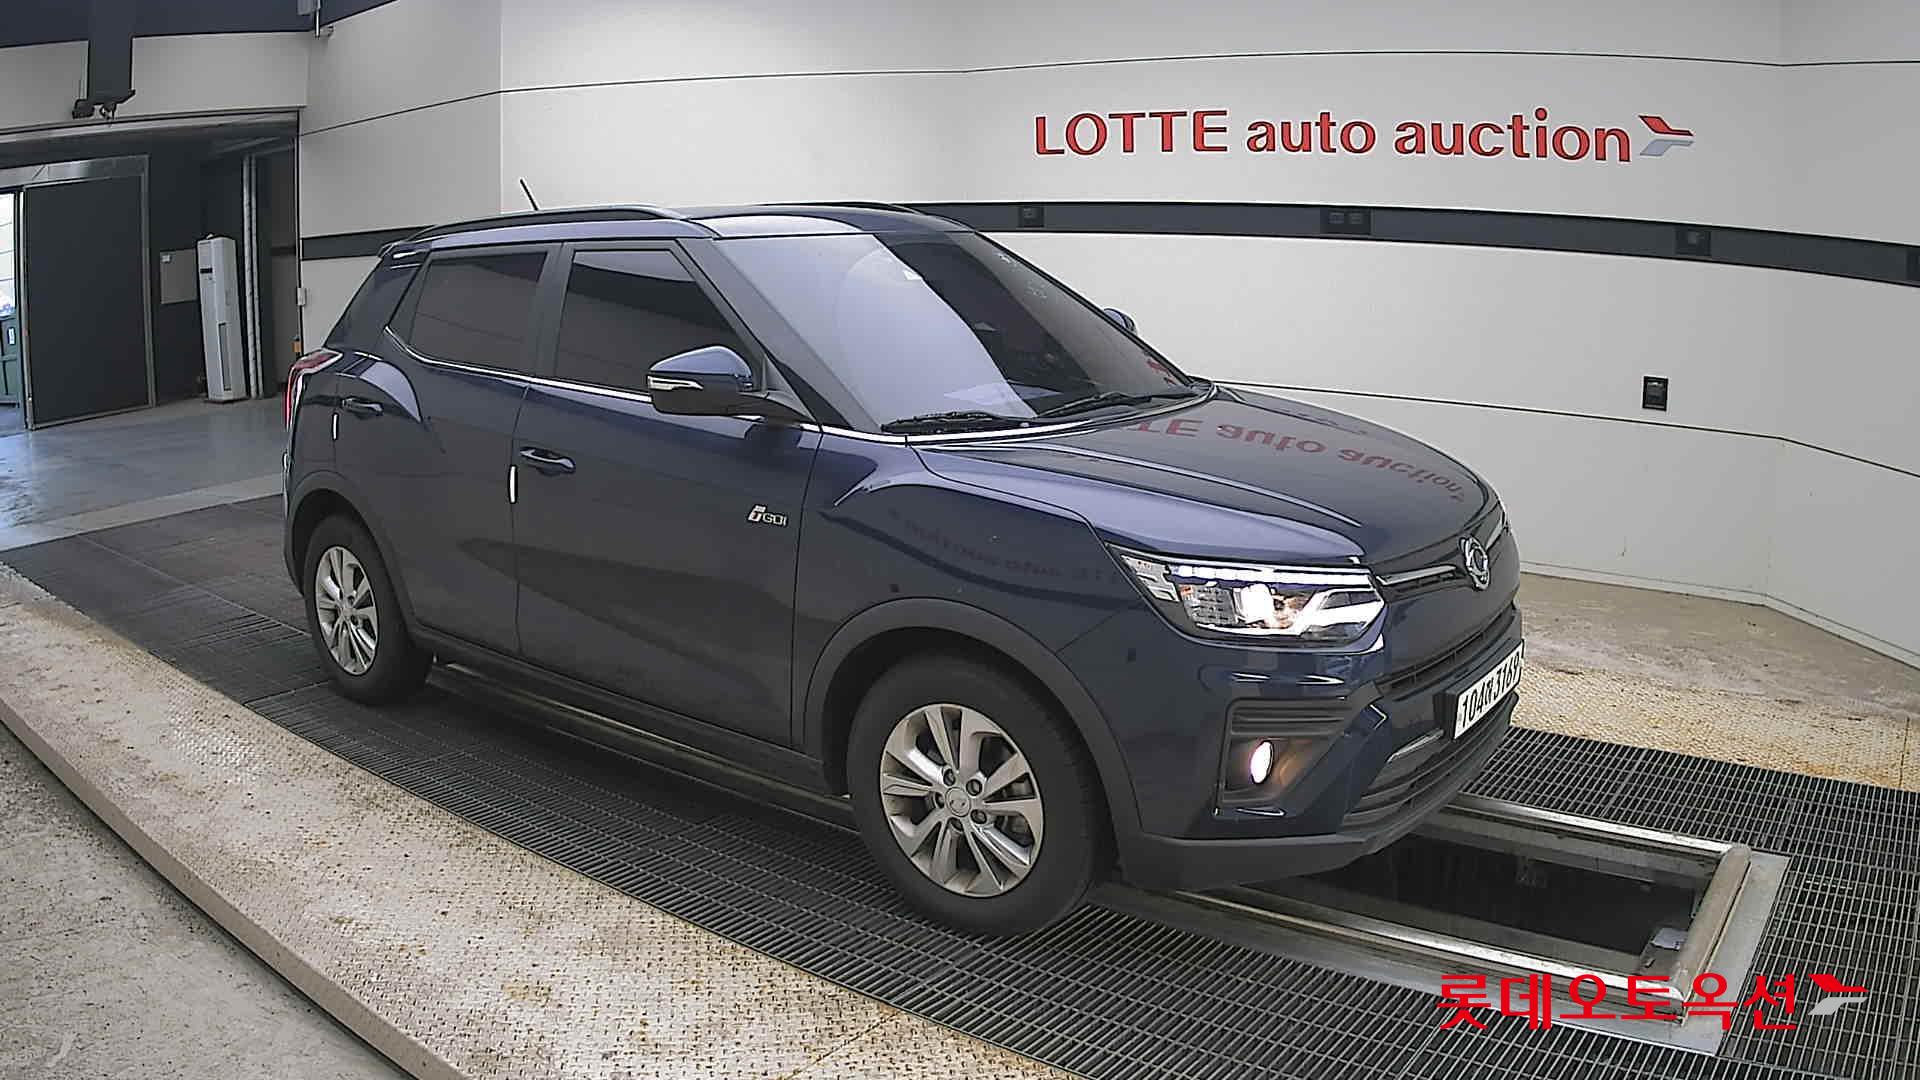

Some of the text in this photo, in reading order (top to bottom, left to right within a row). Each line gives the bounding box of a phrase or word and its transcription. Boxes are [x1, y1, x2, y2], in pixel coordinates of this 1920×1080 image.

[1034, 107, 1632, 162] LOTTE auto auction
